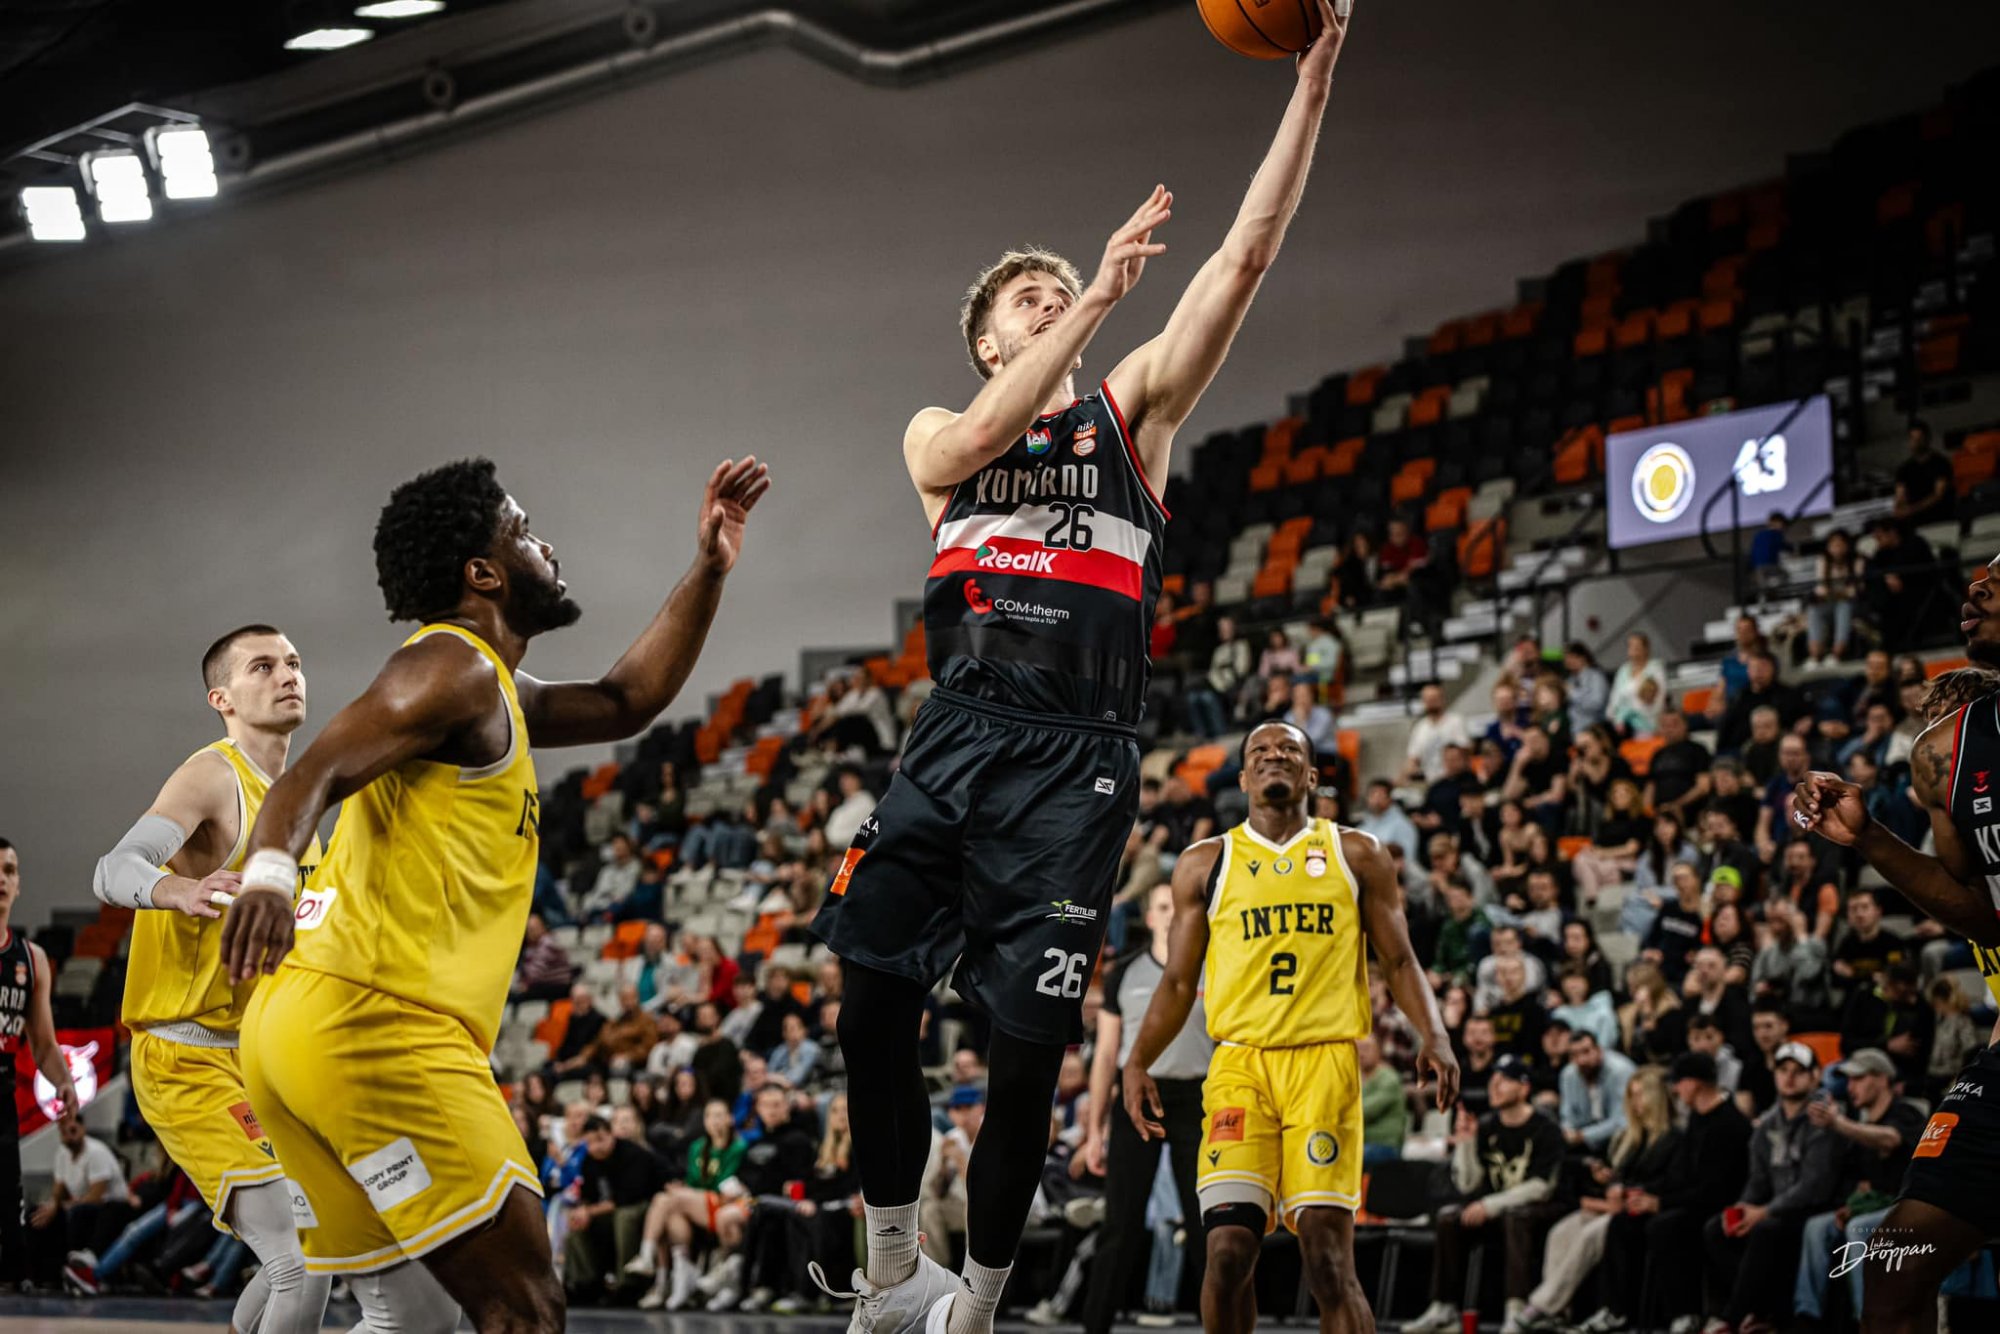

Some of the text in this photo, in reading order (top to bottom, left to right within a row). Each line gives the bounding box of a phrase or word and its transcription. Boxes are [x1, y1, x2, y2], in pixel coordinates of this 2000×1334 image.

[1043, 501, 1096, 553] 26
[976, 545, 1058, 574] RealK
[994, 598, 1070, 620] COM-therm
[1240, 903, 1335, 941] INTER
[1035, 947, 1088, 999] 26
[1269, 952, 1297, 996] 2
[364, 1154, 414, 1187] COPY PRINT
[377, 1169, 407, 1192] GROUP
